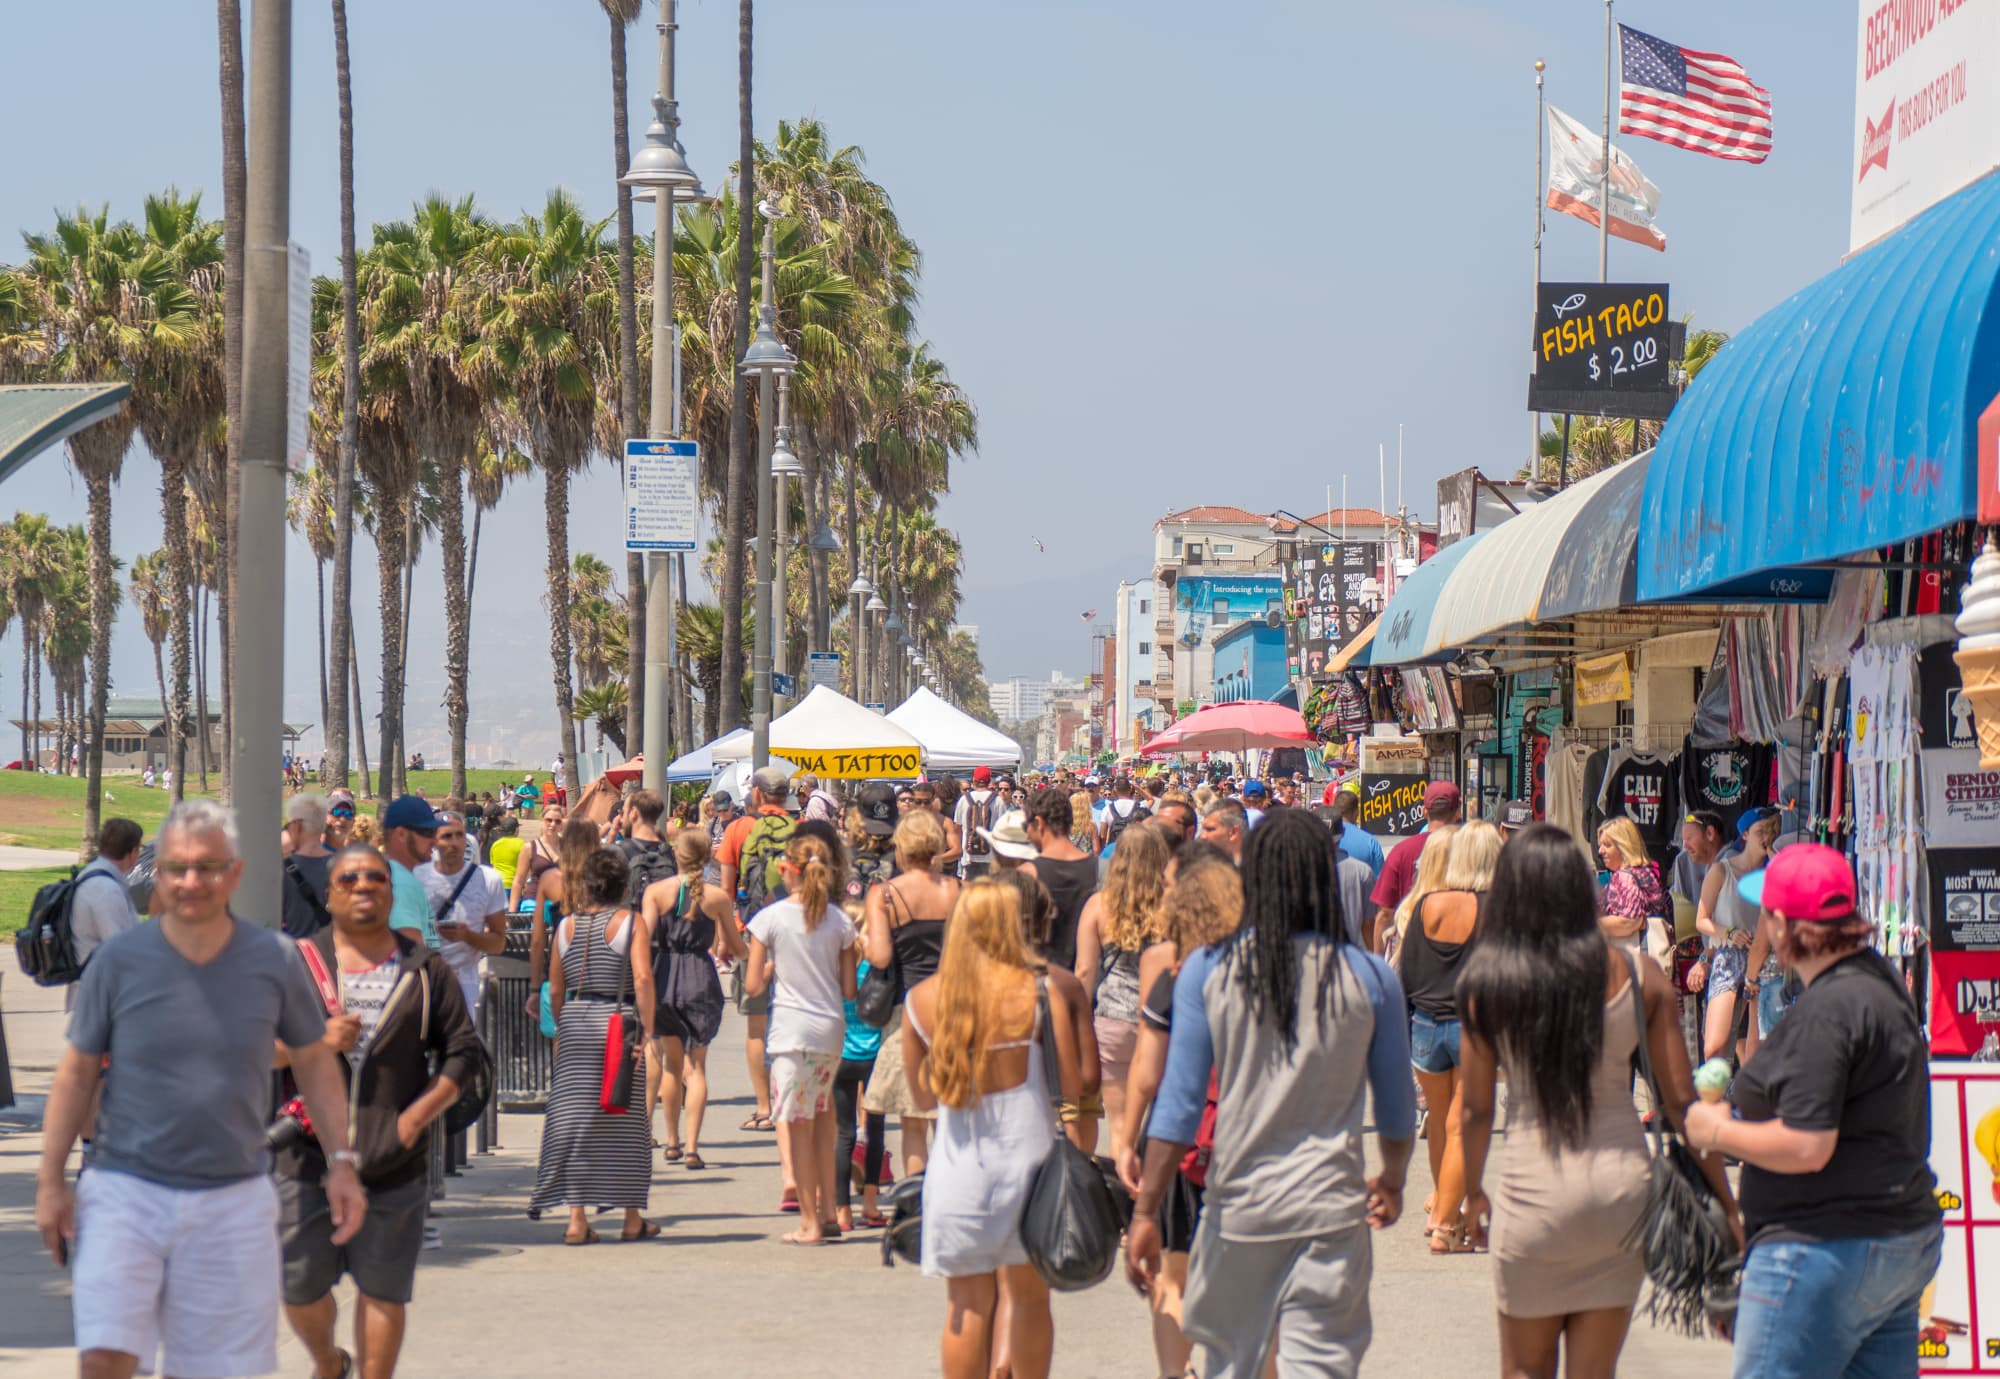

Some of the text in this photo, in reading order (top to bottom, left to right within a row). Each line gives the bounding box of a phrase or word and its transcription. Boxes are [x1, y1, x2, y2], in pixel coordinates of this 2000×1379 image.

[1898, 96, 1912, 145] THIS
[1913, 80, 1934, 133] BUD'S
[1935, 72, 1949, 116] FOR
[1542, 293, 1664, 362] FISH TACO
[1588, 336, 1657, 382] $ 2.00
[1213, 584, 1252, 596] Introducing
[1253, 585, 1264, 593] the
[1951, 740, 1976, 748] GAME
[833, 753, 917, 774] TATTOO
[1624, 775, 1662, 797] CALI
[1946, 772, 2000, 786] SENIO
[1363, 780, 1428, 823] FISH TACO
[1387, 816, 1396, 833] $
[1945, 877, 1973, 890] MOST
